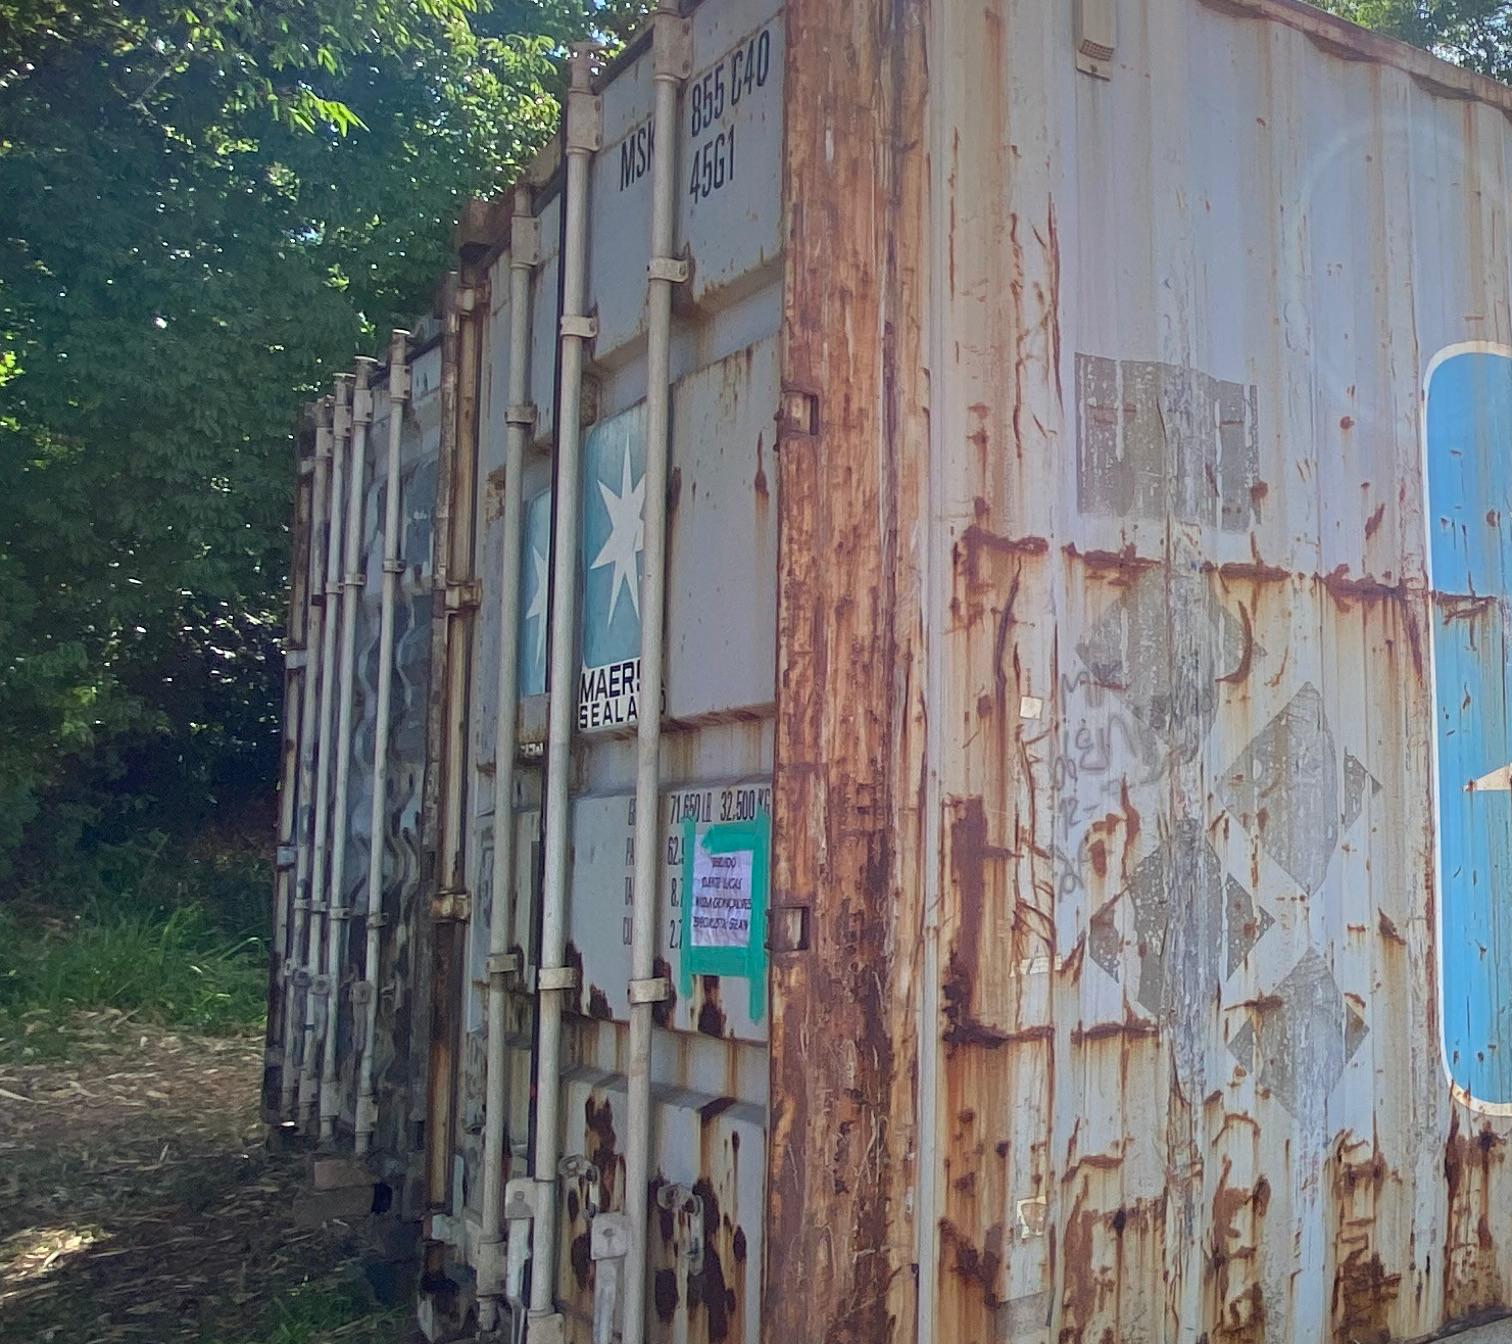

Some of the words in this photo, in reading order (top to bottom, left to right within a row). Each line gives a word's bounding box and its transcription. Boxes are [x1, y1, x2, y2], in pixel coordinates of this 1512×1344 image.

[691, 64, 724, 137] 855
[690, 124, 734, 204] 45G1
[580, 659, 641, 704] MAER
[720, 790, 755, 821] 32.500
